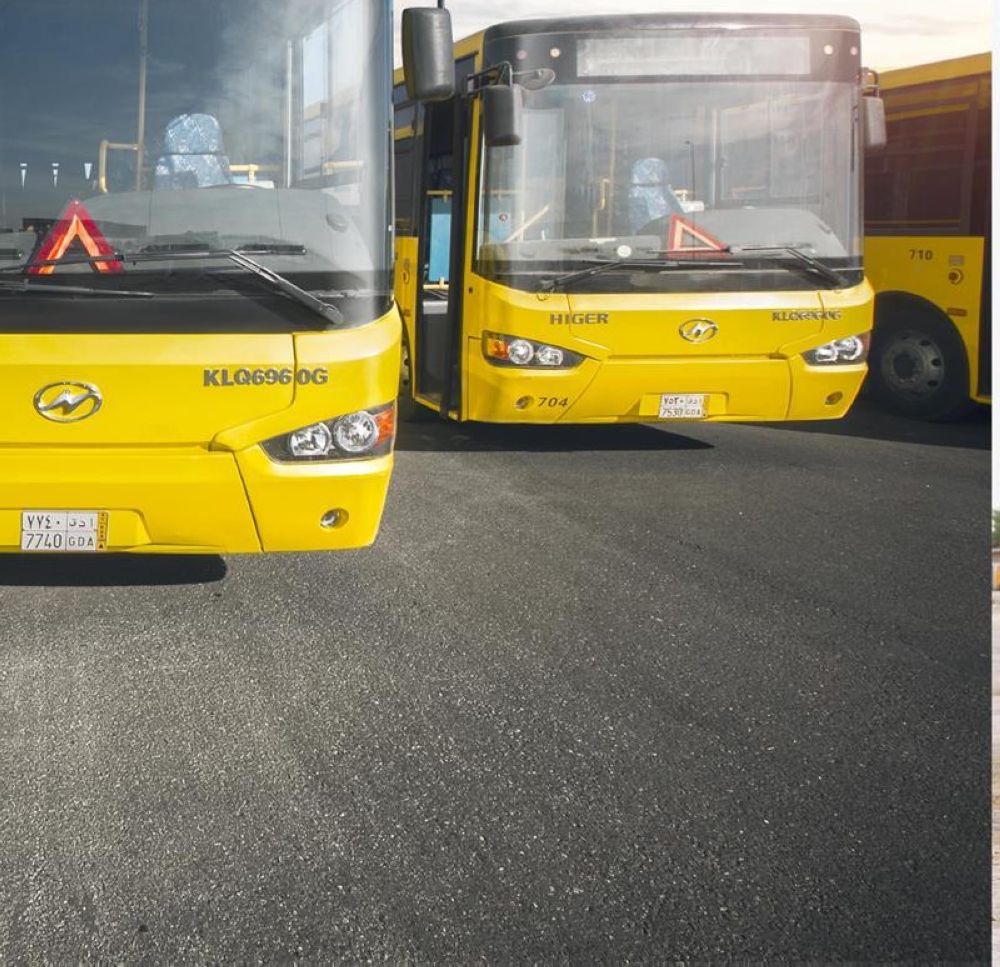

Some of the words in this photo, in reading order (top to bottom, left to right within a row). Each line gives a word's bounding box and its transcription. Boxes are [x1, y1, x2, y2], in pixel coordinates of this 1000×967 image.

[908, 249, 933, 261] 710
[549, 313, 609, 325] HIGER
[203, 368, 328, 387] KLQ6960G
[538, 396, 569, 408] 704
[26, 533, 62, 549] 7740
